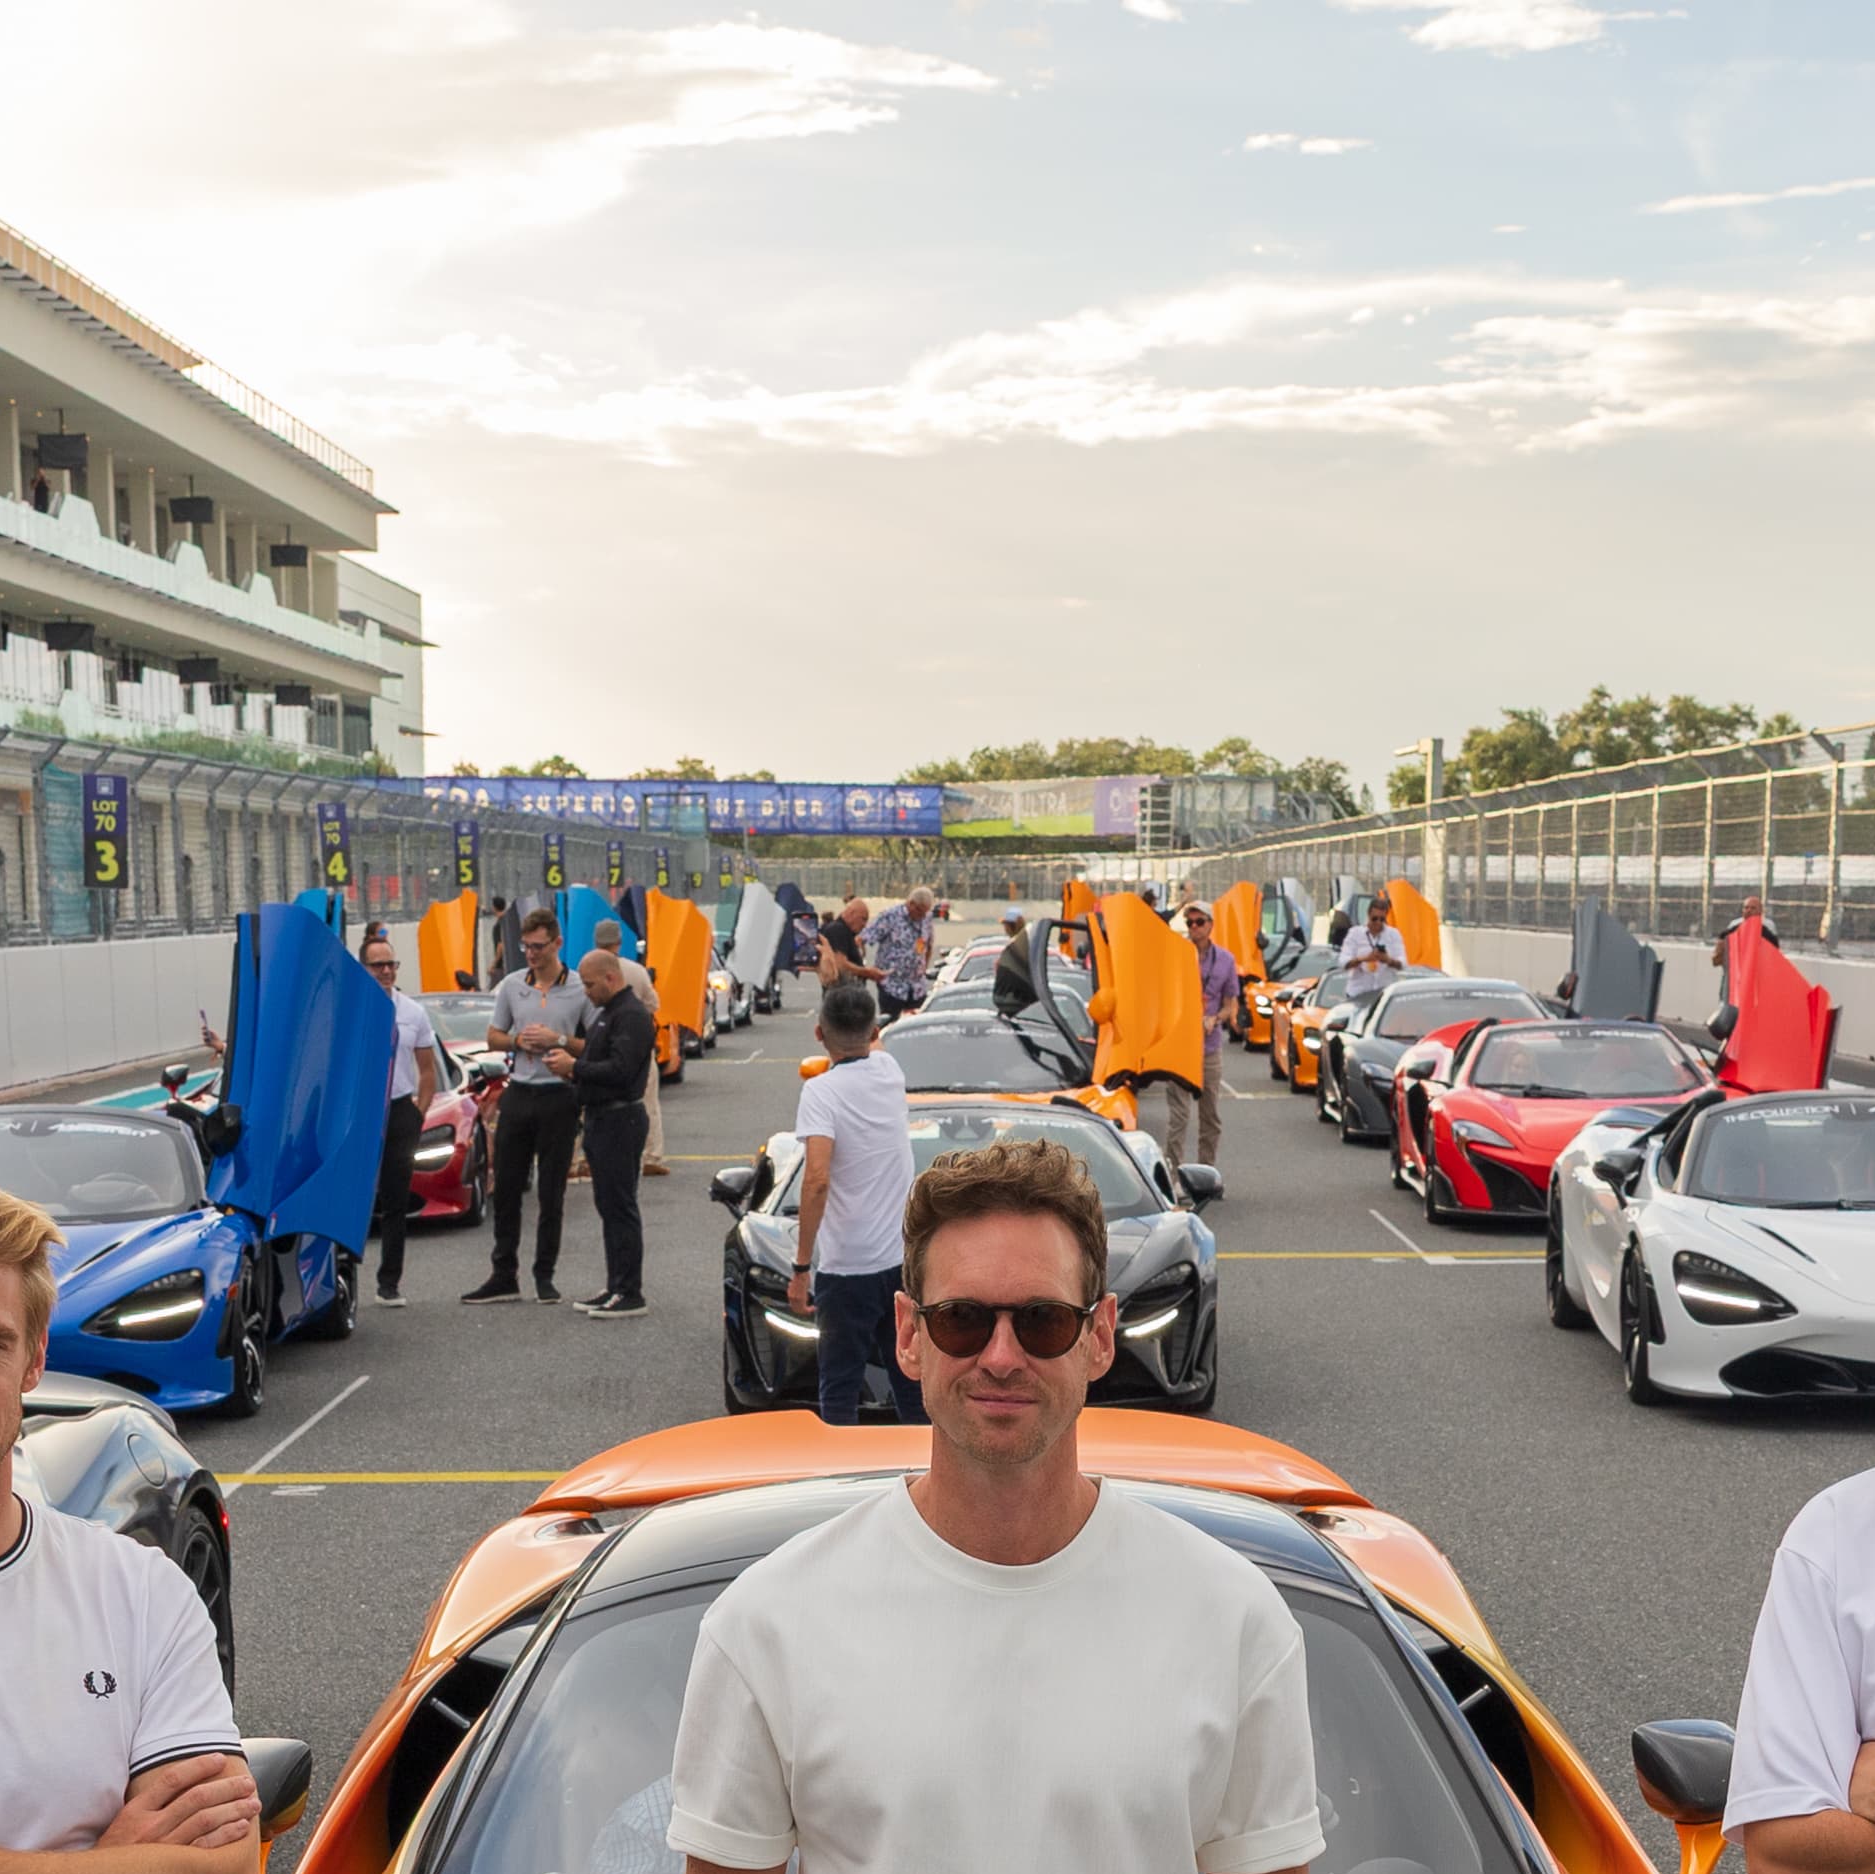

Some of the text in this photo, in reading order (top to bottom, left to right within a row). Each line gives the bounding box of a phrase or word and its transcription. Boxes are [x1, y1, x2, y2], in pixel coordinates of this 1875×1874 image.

[92, 799, 119, 813] LOT
[93, 814, 117, 833] 70
[94, 839, 120, 882] 3
[327, 850, 348, 883] 4
[458, 858, 474, 885] 5
[546, 864, 563, 887] 6
[608, 866, 621, 886] 7
[657, 869, 669, 887] 8
[692, 870, 703, 888] 9
